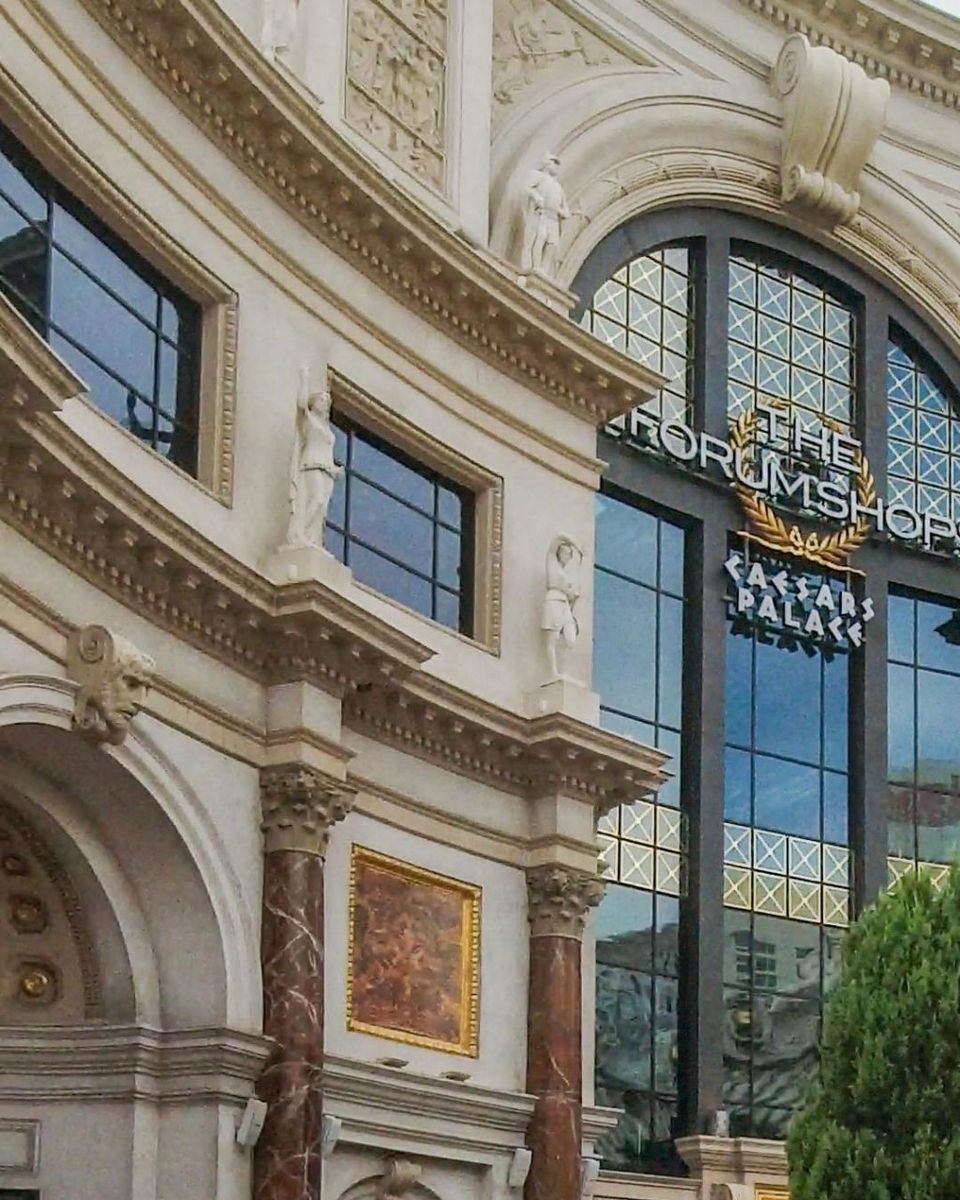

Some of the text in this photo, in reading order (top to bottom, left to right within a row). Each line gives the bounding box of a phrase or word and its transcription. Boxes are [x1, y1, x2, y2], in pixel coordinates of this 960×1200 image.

[630, 409, 809, 506] FORUM
[755, 404, 861, 474] THE
[724, 556, 875, 621] CAESARS
[737, 588, 865, 647] PALACE
